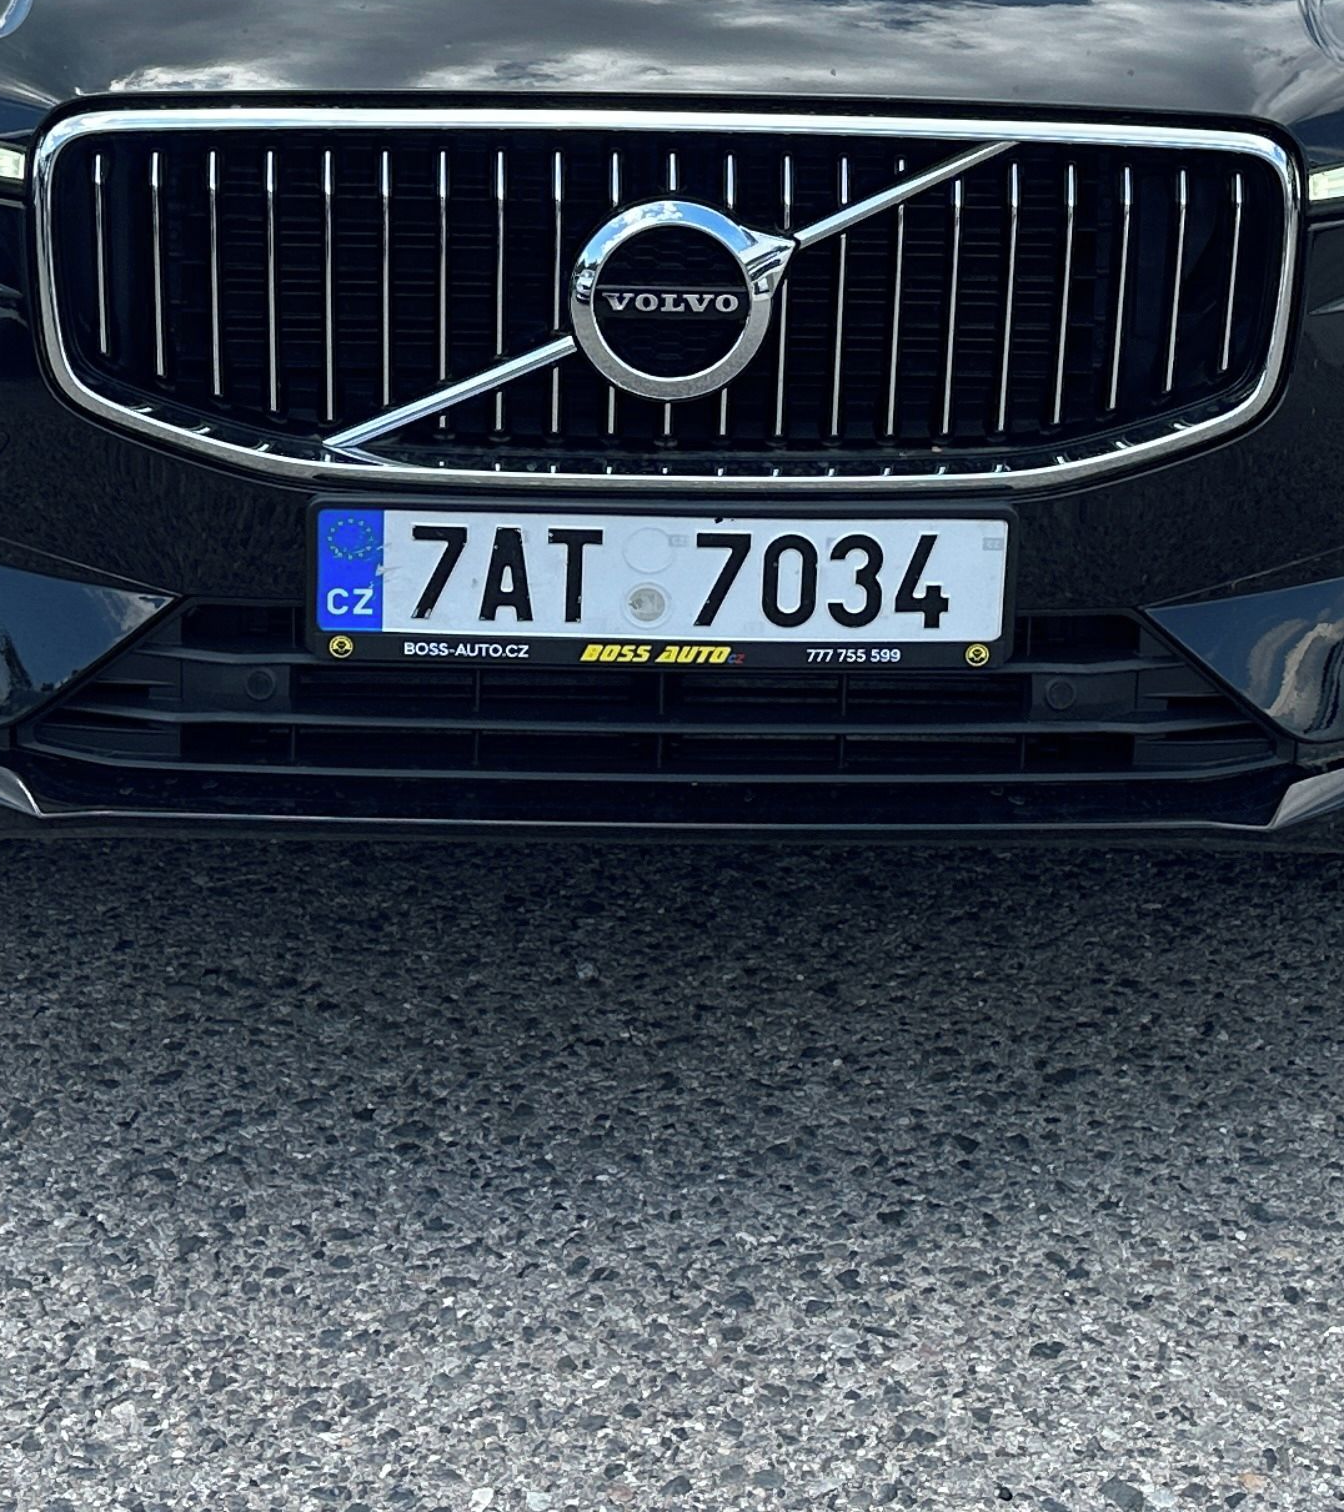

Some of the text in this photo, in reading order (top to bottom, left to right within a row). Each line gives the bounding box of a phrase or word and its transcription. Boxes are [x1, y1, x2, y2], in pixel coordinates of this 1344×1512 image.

[601, 292, 739, 313] VOLVO
[410, 525, 950, 629] 7AT 7034
[326, 587, 374, 616] CZ
[404, 641, 530, 659] BOSS-AUTO.CZ
[579, 643, 653, 663] BOSS
[655, 645, 732, 664] AUTO
[806, 648, 834, 663] 777
[837, 648, 866, 663] 755
[870, 648, 902, 663] 599
